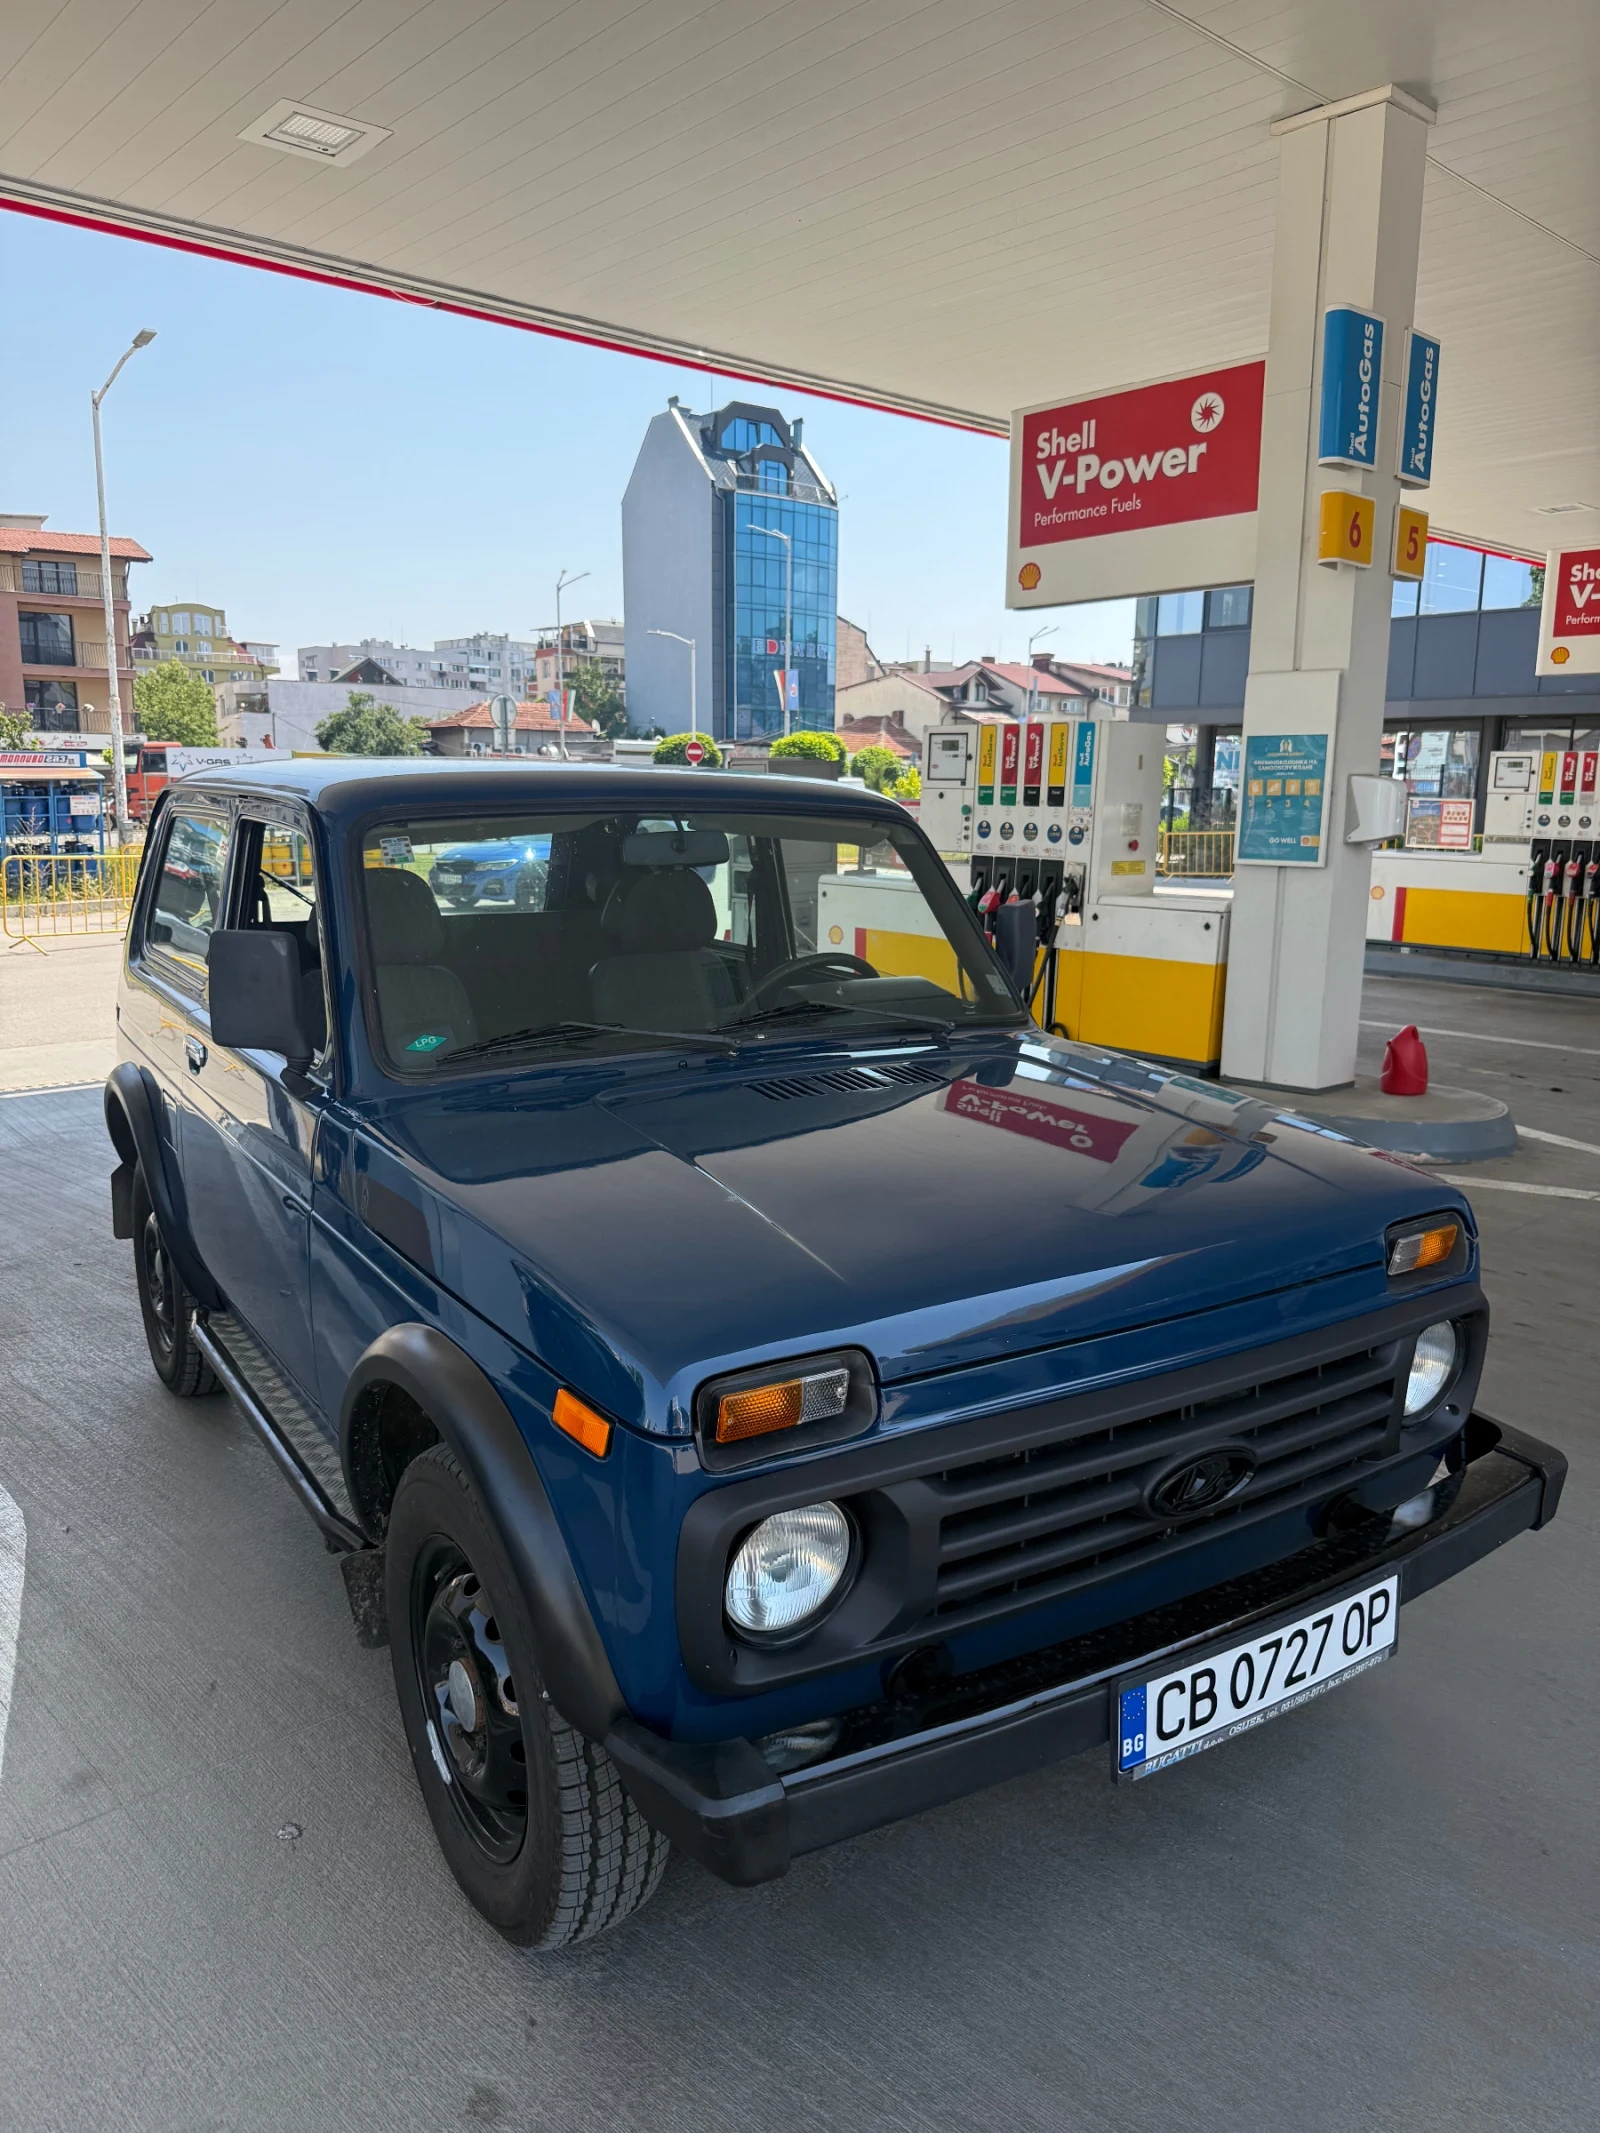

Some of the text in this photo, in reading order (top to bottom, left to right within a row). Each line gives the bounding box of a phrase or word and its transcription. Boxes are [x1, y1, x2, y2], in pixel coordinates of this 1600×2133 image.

[1354, 323, 1374, 456] AutoGas
[1413, 346, 1434, 473] AutoGas
[1036, 419, 1096, 460] Shell
[1037, 441, 1207, 500] V-Power
[1034, 493, 1142, 528] Performance Fuels
[1349, 511, 1361, 548] 6
[1406, 526, 1419, 561] 5
[195, 757, 231, 766] V-GAS
[1032, 736, 1040, 768] V-Power
[1083, 731, 1092, 766] AutoGas
[1266, 799, 1272, 808] 2
[1285, 799, 1291, 808] 3
[1303, 799, 1310, 808] 4
[415, 1036, 437, 1048] LPG
[1156, 1588, 1390, 1741] CB 0727 OP
[1122, 1733, 1144, 1758] BG
[1143, 1739, 1204, 1777] BUGATTI
[1203, 1736, 1224, 1750] d.o.o.
[1228, 1713, 1265, 1736] OSIJEK,
